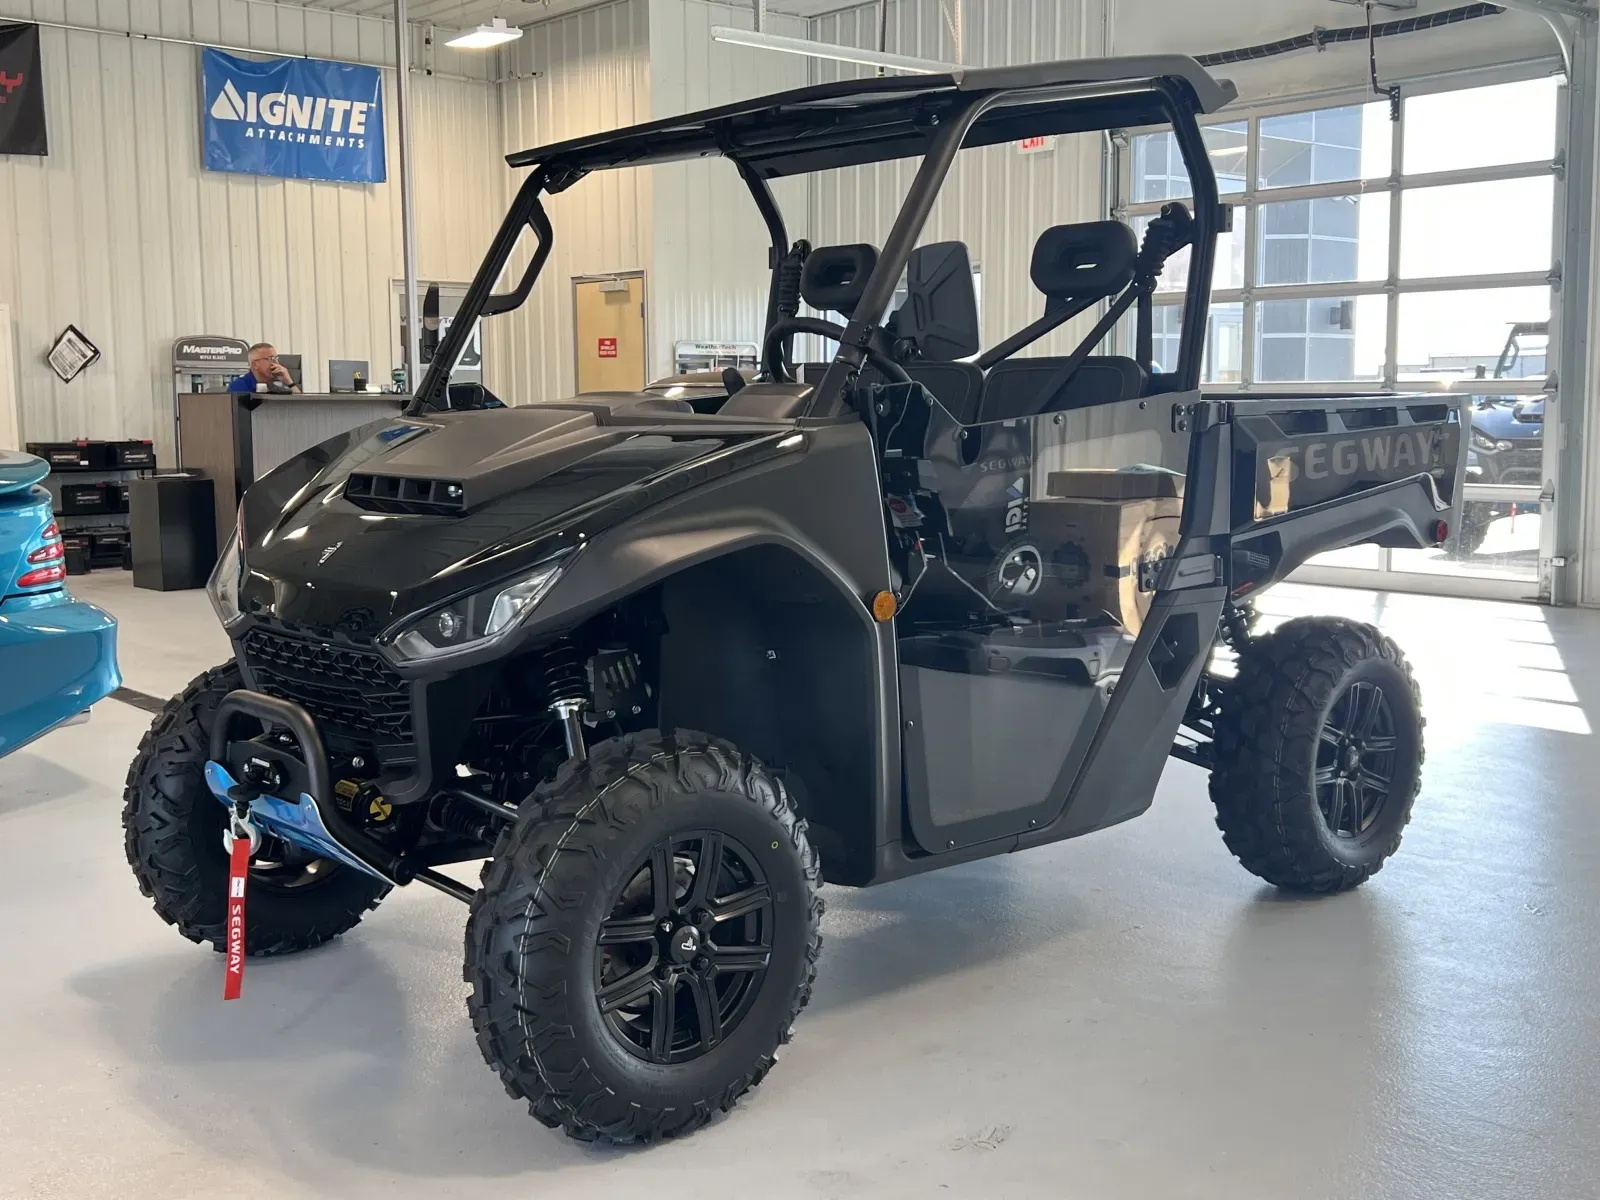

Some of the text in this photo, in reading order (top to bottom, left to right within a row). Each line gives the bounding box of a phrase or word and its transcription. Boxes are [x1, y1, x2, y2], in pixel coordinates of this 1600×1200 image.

[246, 91, 368, 135] IGNITE
[245, 127, 365, 149] ATTACHMENTS
[230, 904, 242, 974] SEGWAY
